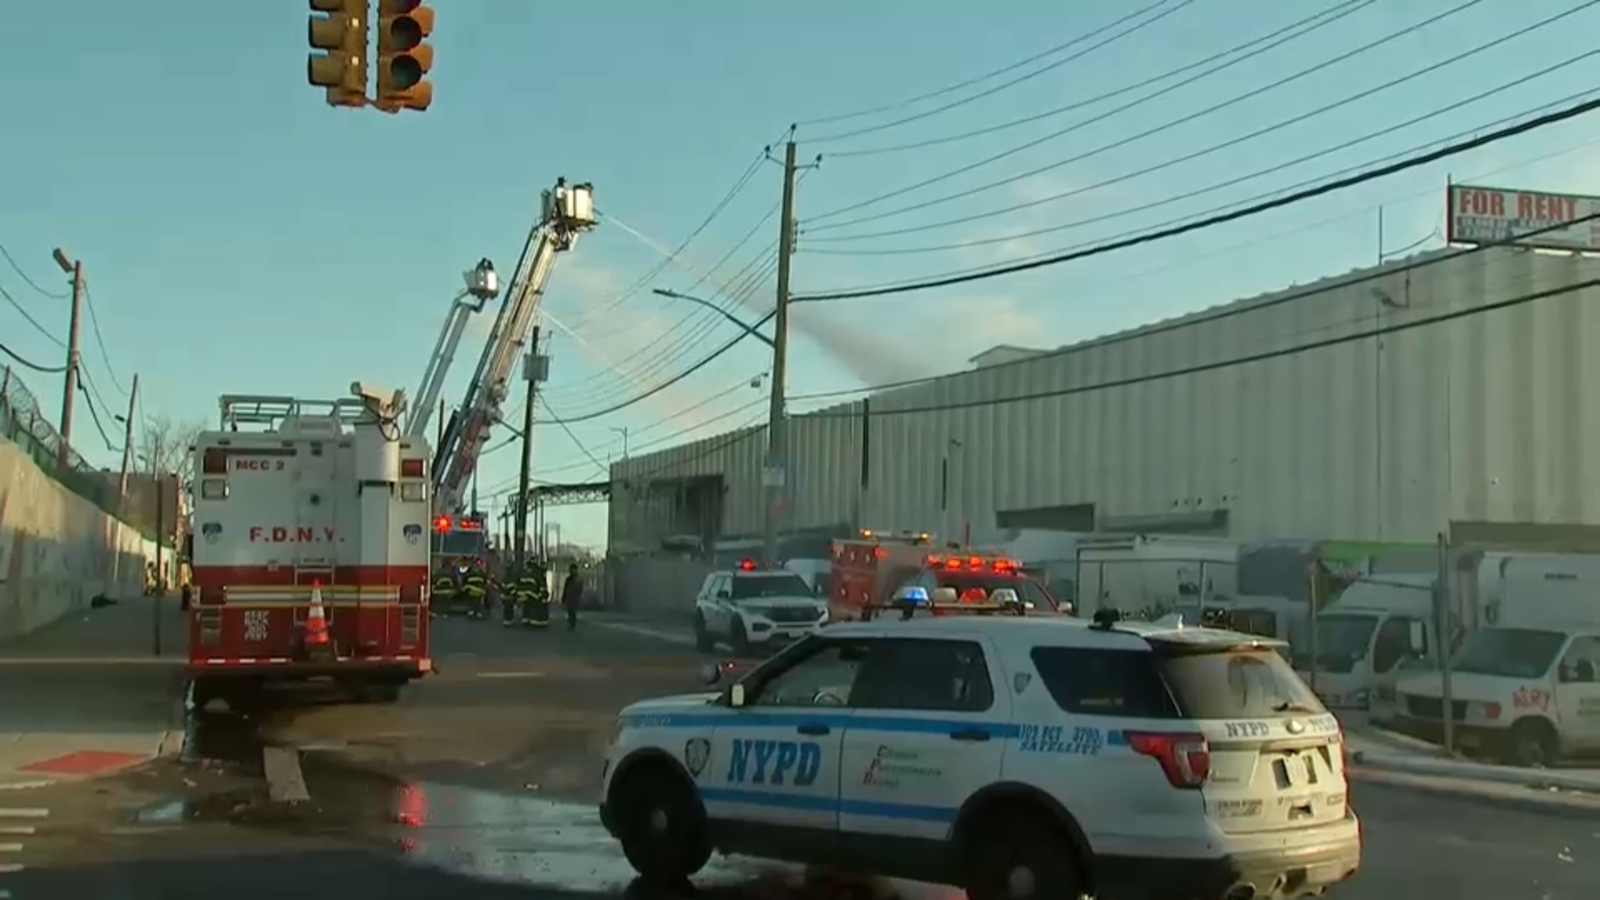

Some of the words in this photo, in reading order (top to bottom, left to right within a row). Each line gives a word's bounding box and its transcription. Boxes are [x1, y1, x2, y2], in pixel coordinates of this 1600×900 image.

[1460, 190, 1505, 216] FOR
[1517, 194, 1577, 221] RENT
[236, 460, 270, 471] MCC
[276, 460, 285, 471] 2
[1224, 721, 1270, 738] NYPD
[1020, 740, 1102, 757] SATELLITE
[727, 739, 822, 787] NYPD
